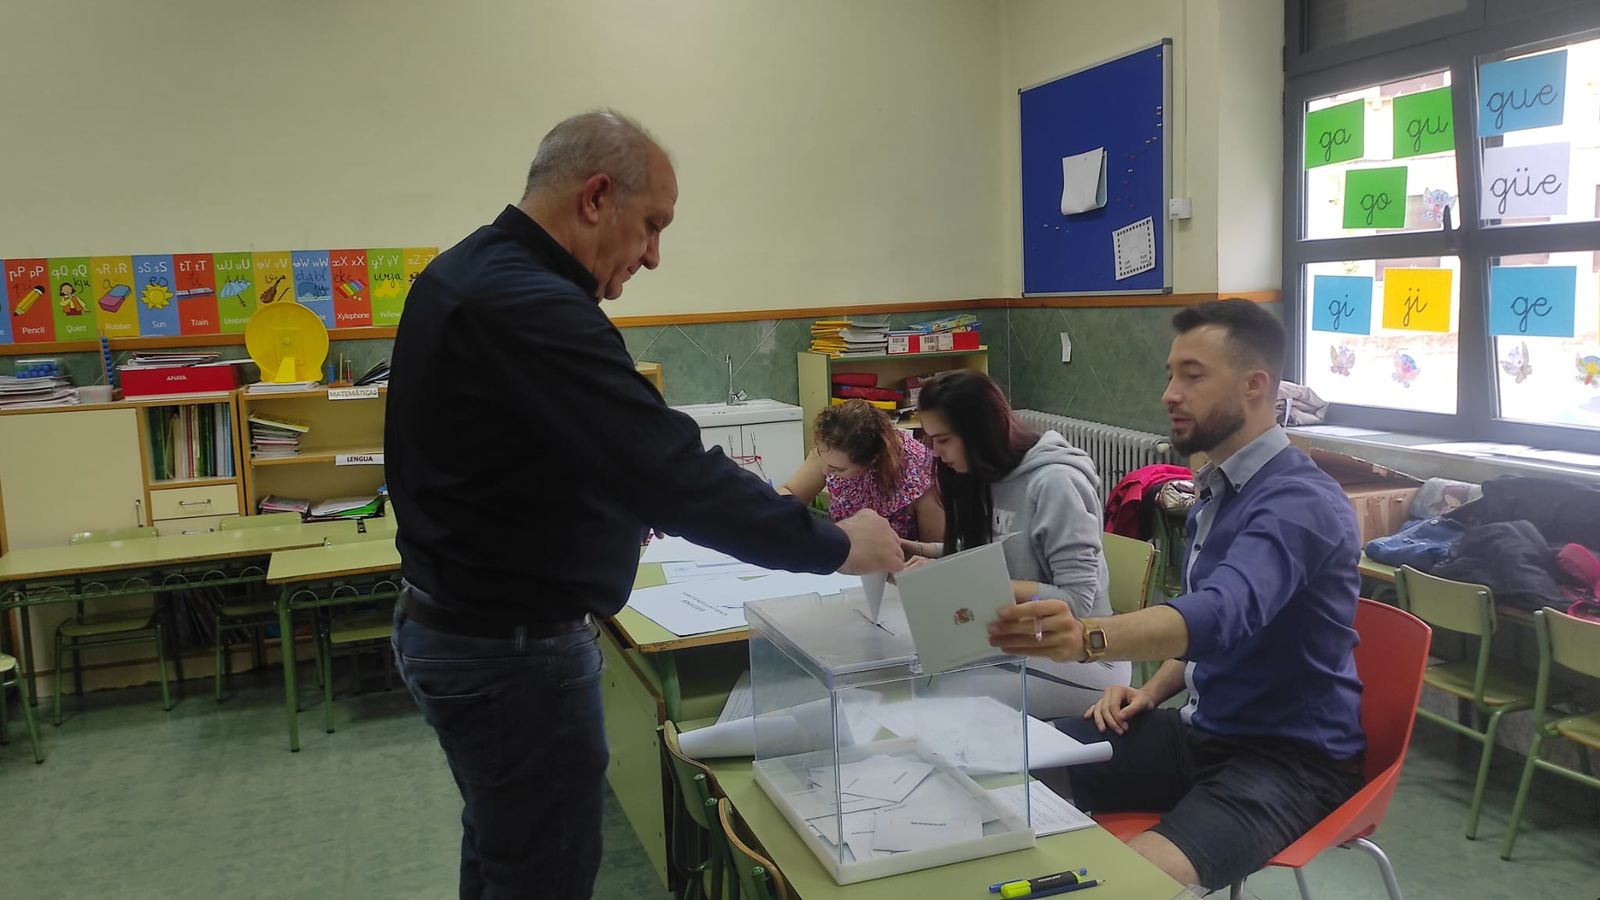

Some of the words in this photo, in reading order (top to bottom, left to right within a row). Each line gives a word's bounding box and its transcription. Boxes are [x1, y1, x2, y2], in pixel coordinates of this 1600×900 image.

[1487, 84, 1558, 128] gue
[1319, 127, 1352, 161] ga
[1406, 114, 1448, 152] gu
[1360, 192, 1392, 225] go
[1489, 167, 1562, 215] güe
[337, 313, 370, 321] Xylophone
[1328, 294, 1355, 330] gi
[1510, 296, 1552, 333] ge
